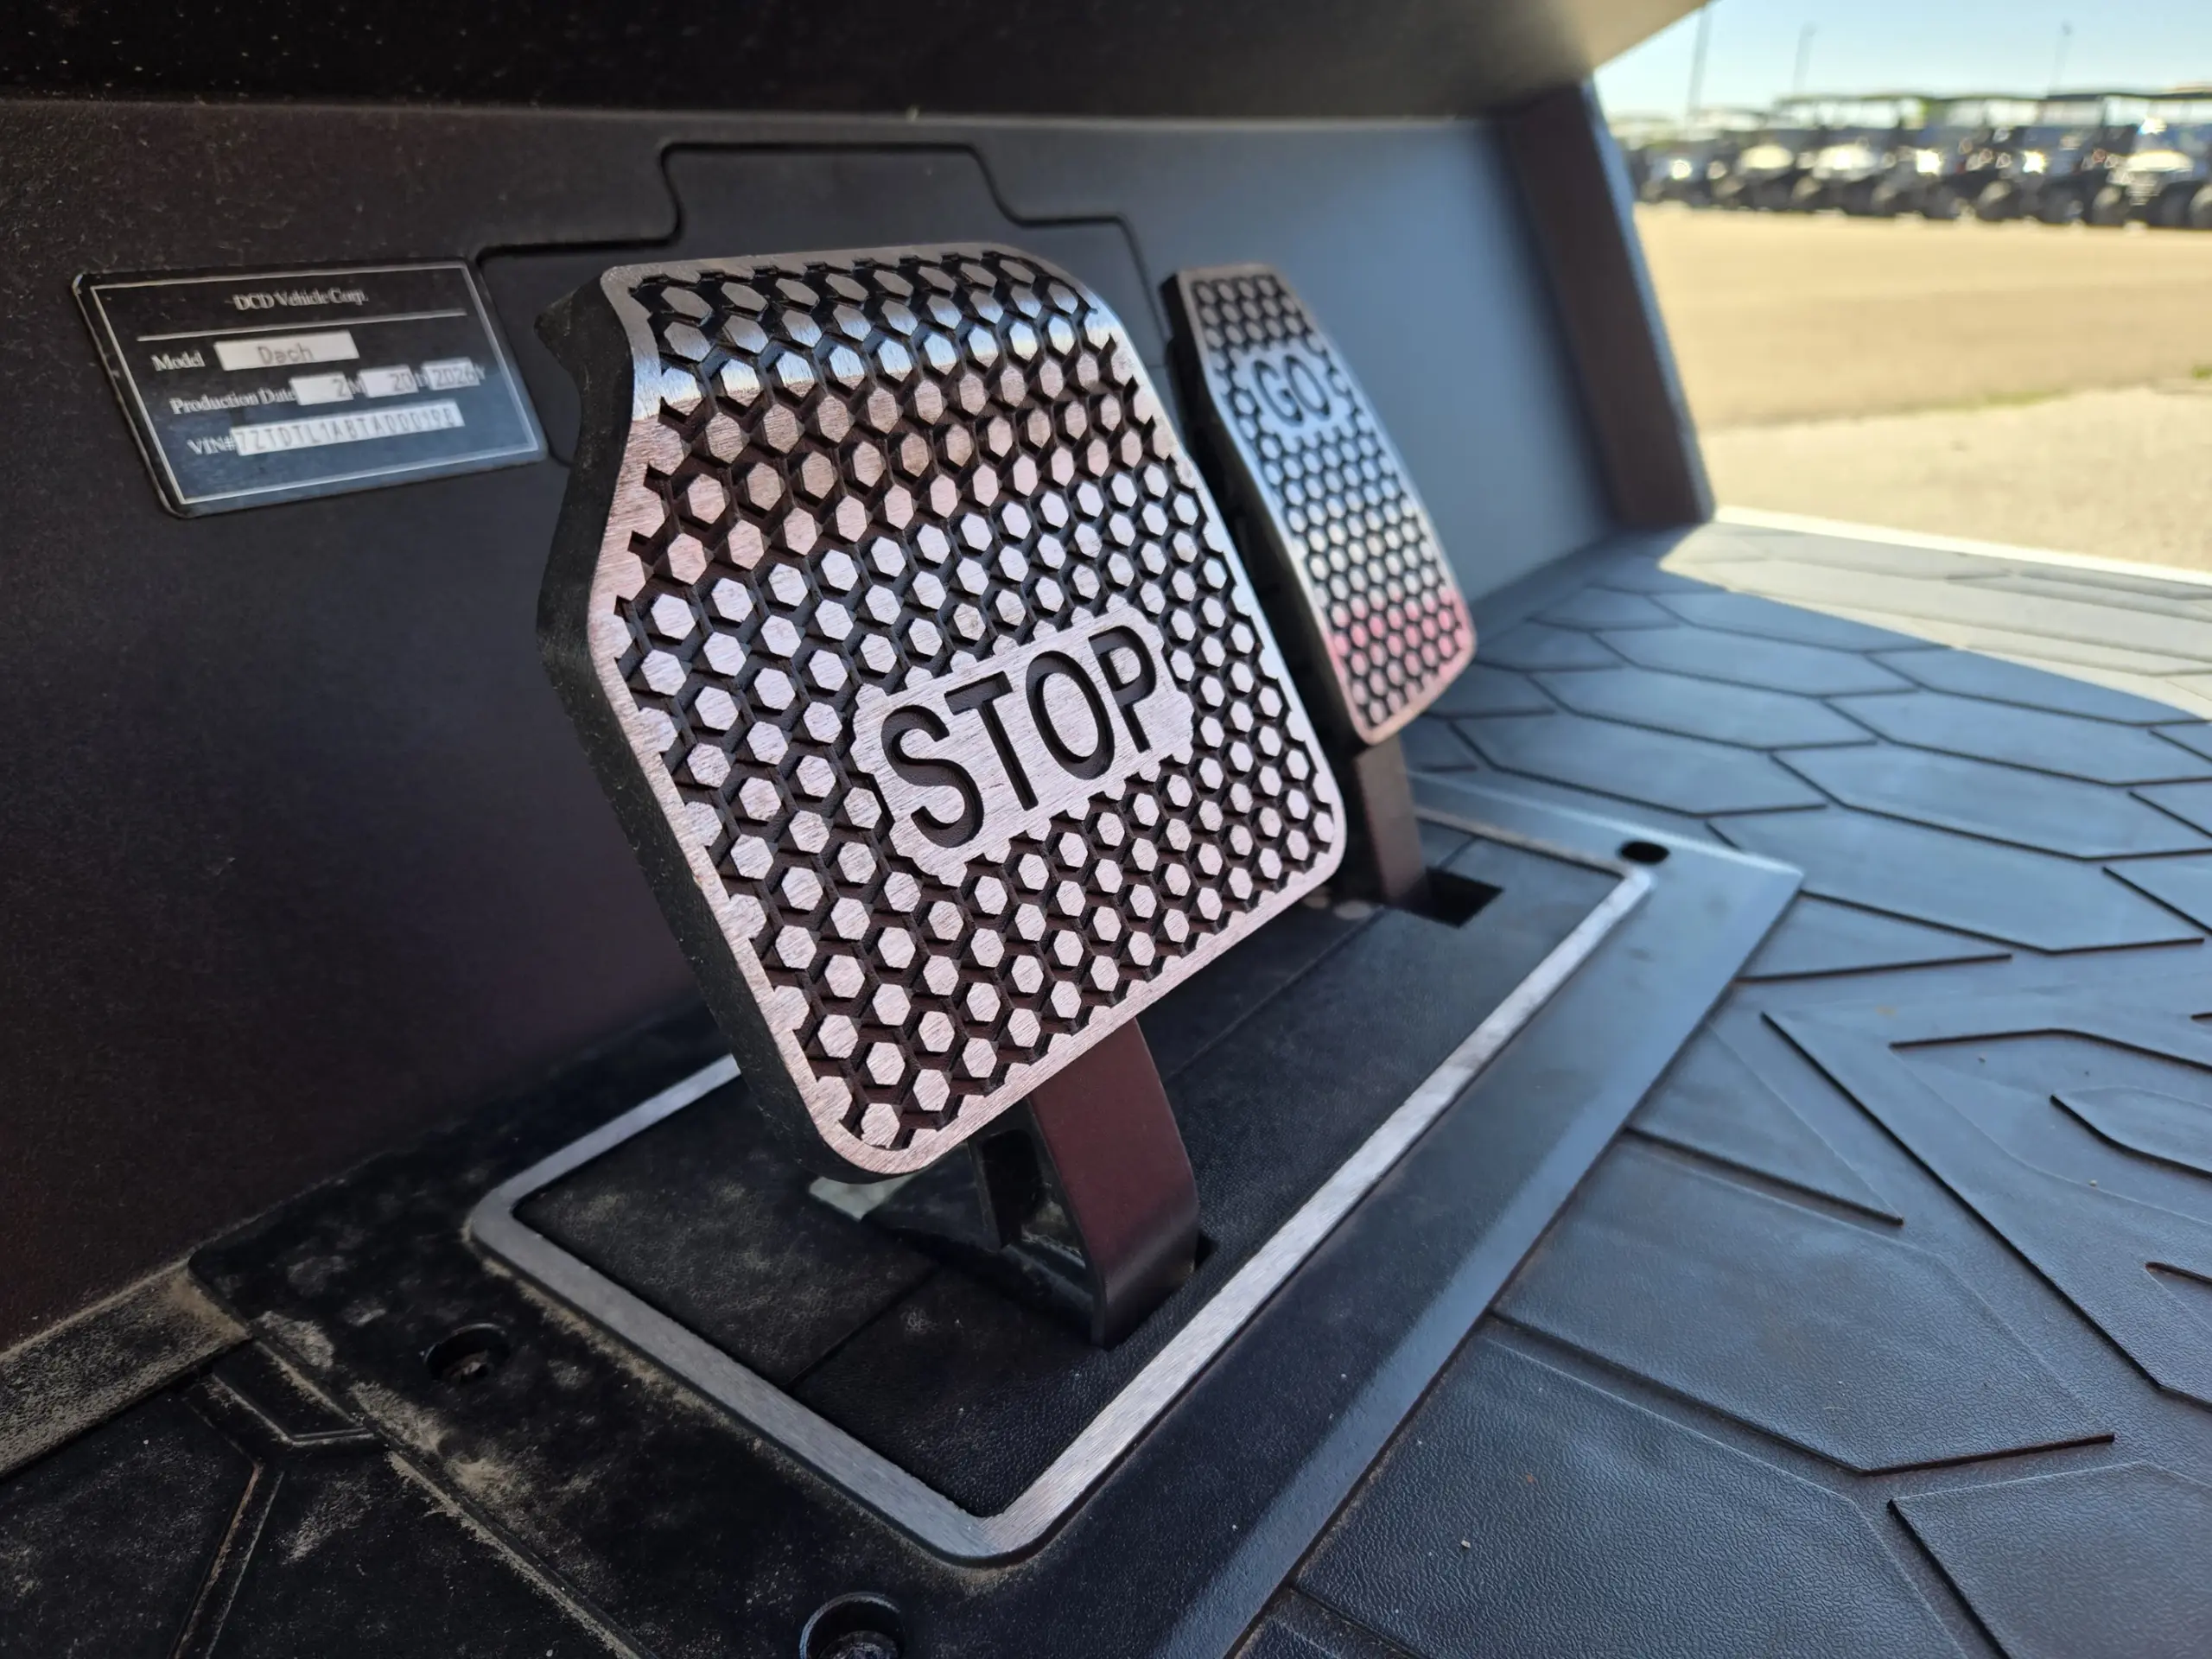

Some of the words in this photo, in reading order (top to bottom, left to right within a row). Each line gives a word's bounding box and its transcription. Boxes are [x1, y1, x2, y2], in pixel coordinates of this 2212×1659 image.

[232, 292, 275, 311] DCD
[273, 288, 329, 307] Vehicle
[150, 349, 207, 372] Model
[169, 391, 261, 415] Production
[258, 386, 299, 404] Date
[333, 378, 348, 397] 2
[390, 372, 415, 392] 20
[1251, 354, 1332, 428] GO
[187, 434, 237, 455] VIN#
[880, 625, 1157, 849] STOP
